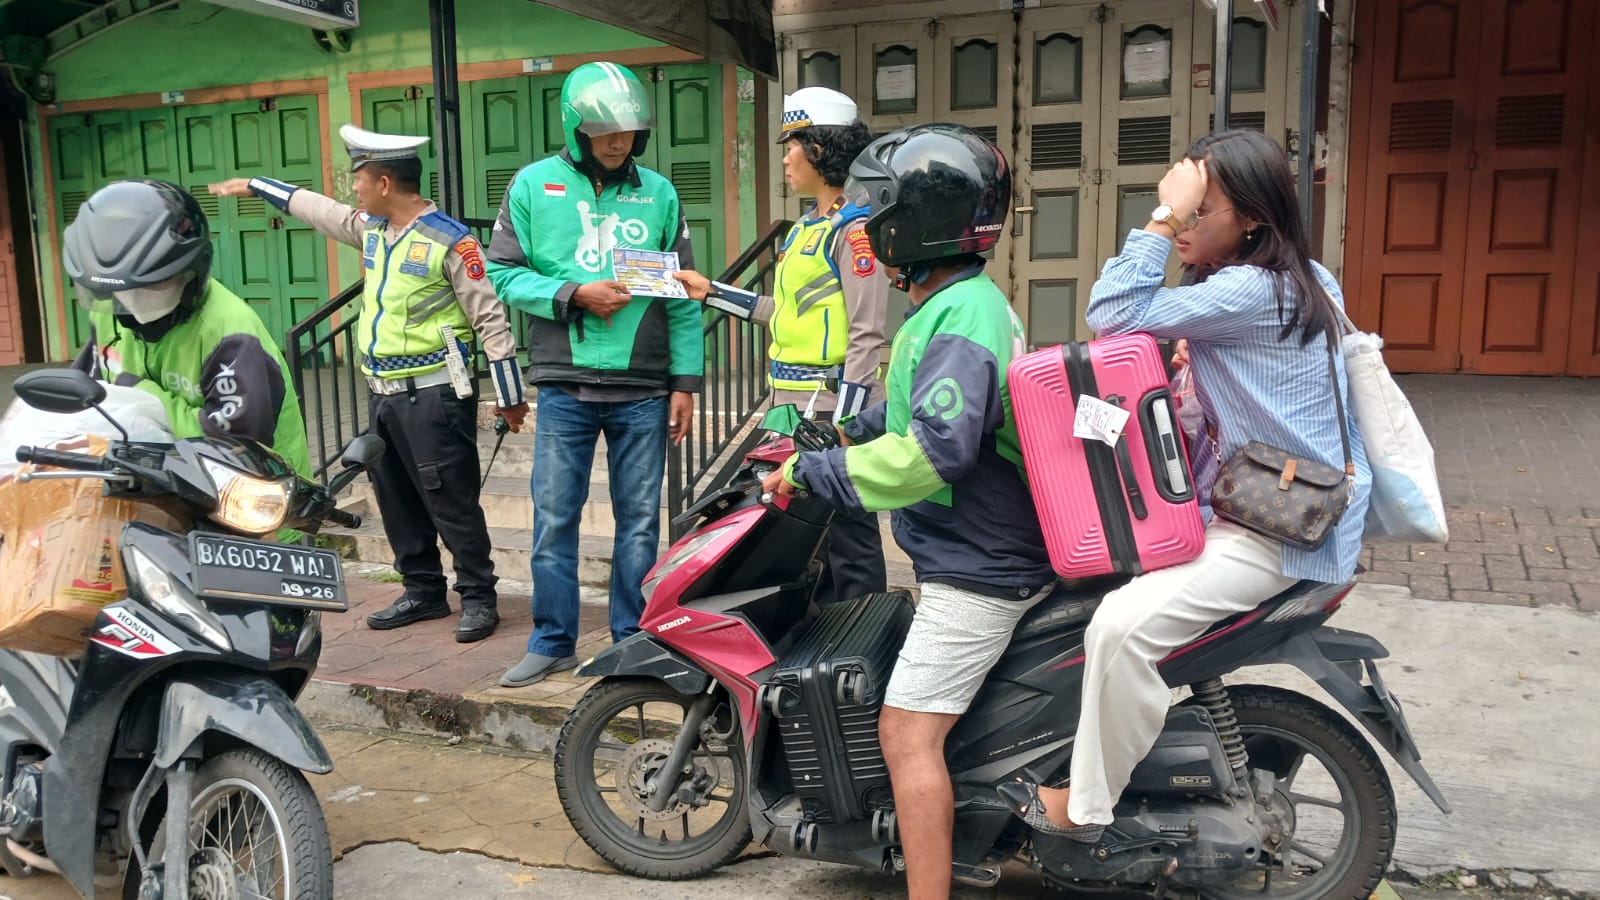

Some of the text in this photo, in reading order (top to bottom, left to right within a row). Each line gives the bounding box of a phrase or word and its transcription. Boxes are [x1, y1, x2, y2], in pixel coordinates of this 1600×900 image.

[610, 99, 641, 114] Grab
[90, 276, 126, 285] HONDA
[165, 371, 204, 402] goje
[116, 611, 156, 642] HONDA
[655, 614, 693, 633] HONDA
